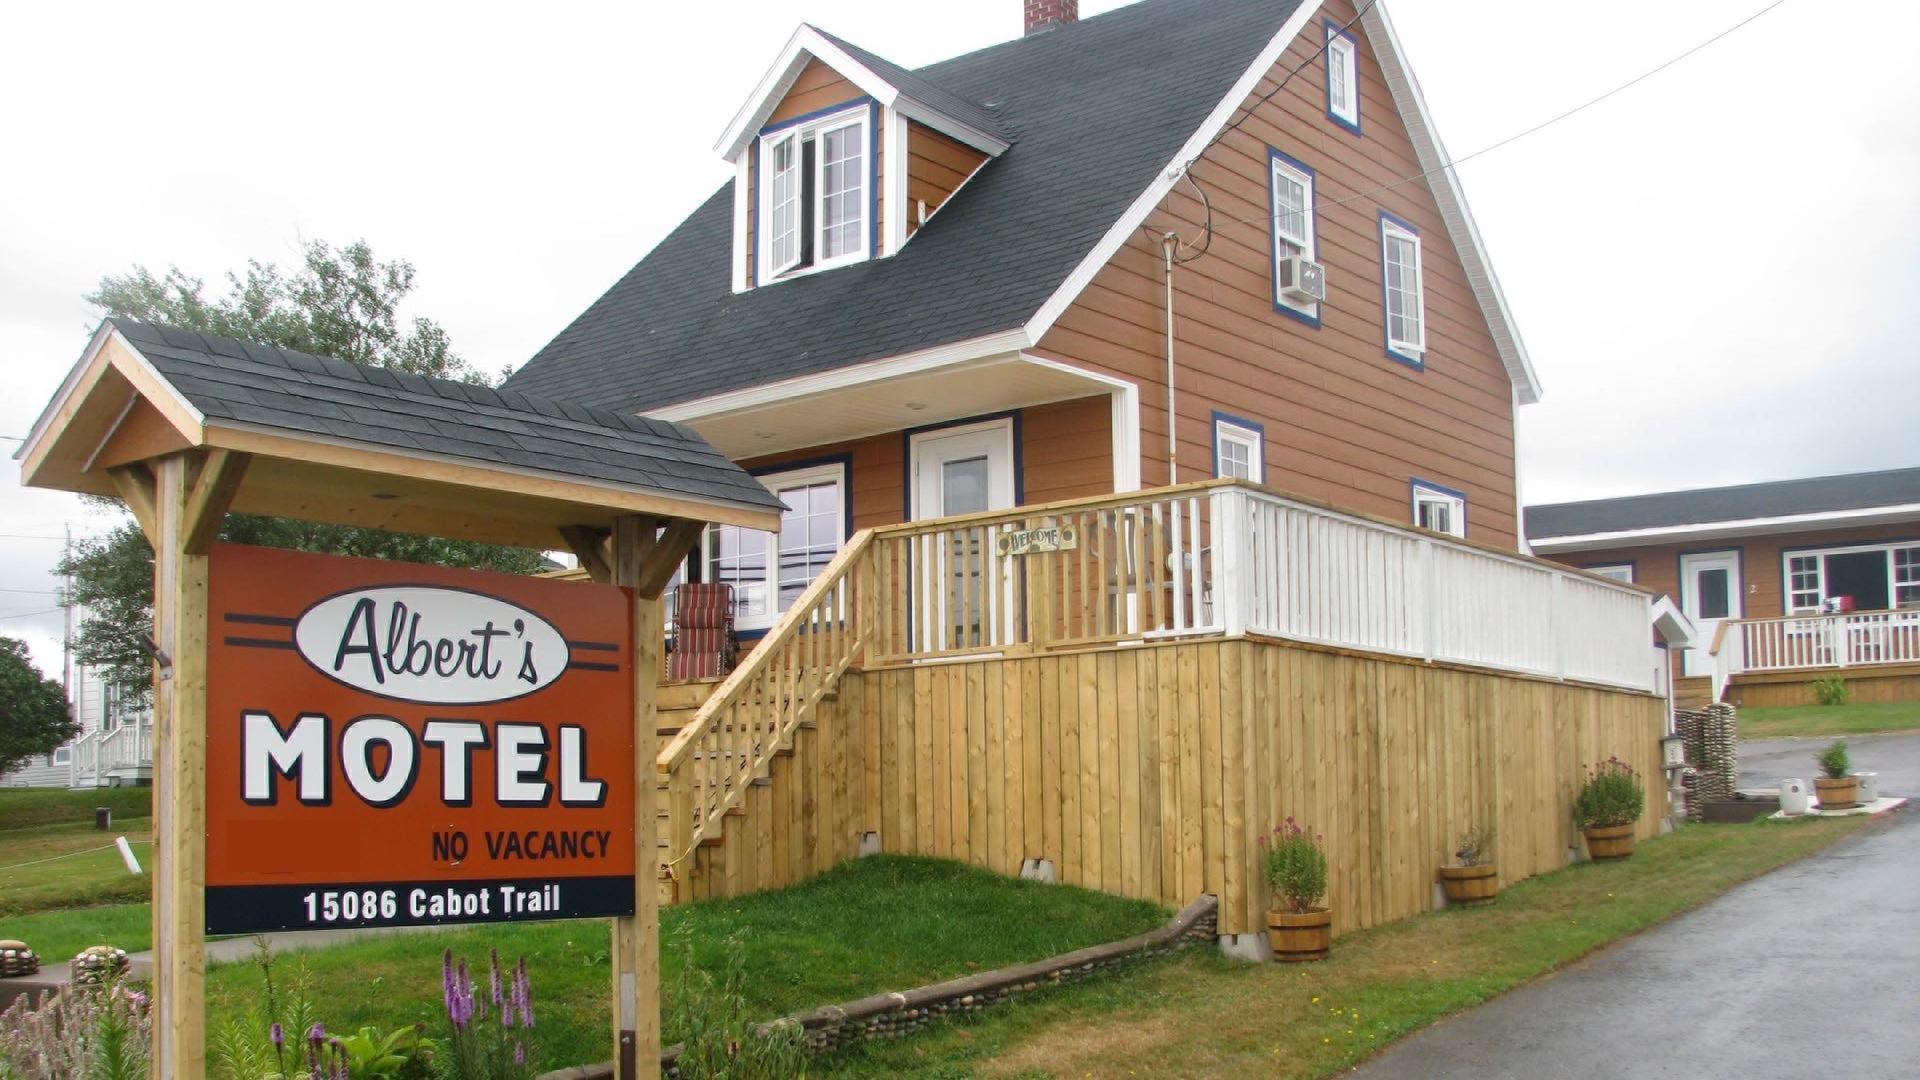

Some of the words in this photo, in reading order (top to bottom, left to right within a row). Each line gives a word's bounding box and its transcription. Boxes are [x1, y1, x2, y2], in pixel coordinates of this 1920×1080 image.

[1011, 529, 1058, 551] WELCOME
[334, 597, 538, 685] Albert's
[240, 710, 609, 808] MOTEL
[432, 830, 469, 862] NO
[485, 830, 611, 860] VACANCY
[304, 889, 397, 921] 15086
[409, 886, 490, 917] Cabot
[501, 884, 561, 913] Trail
